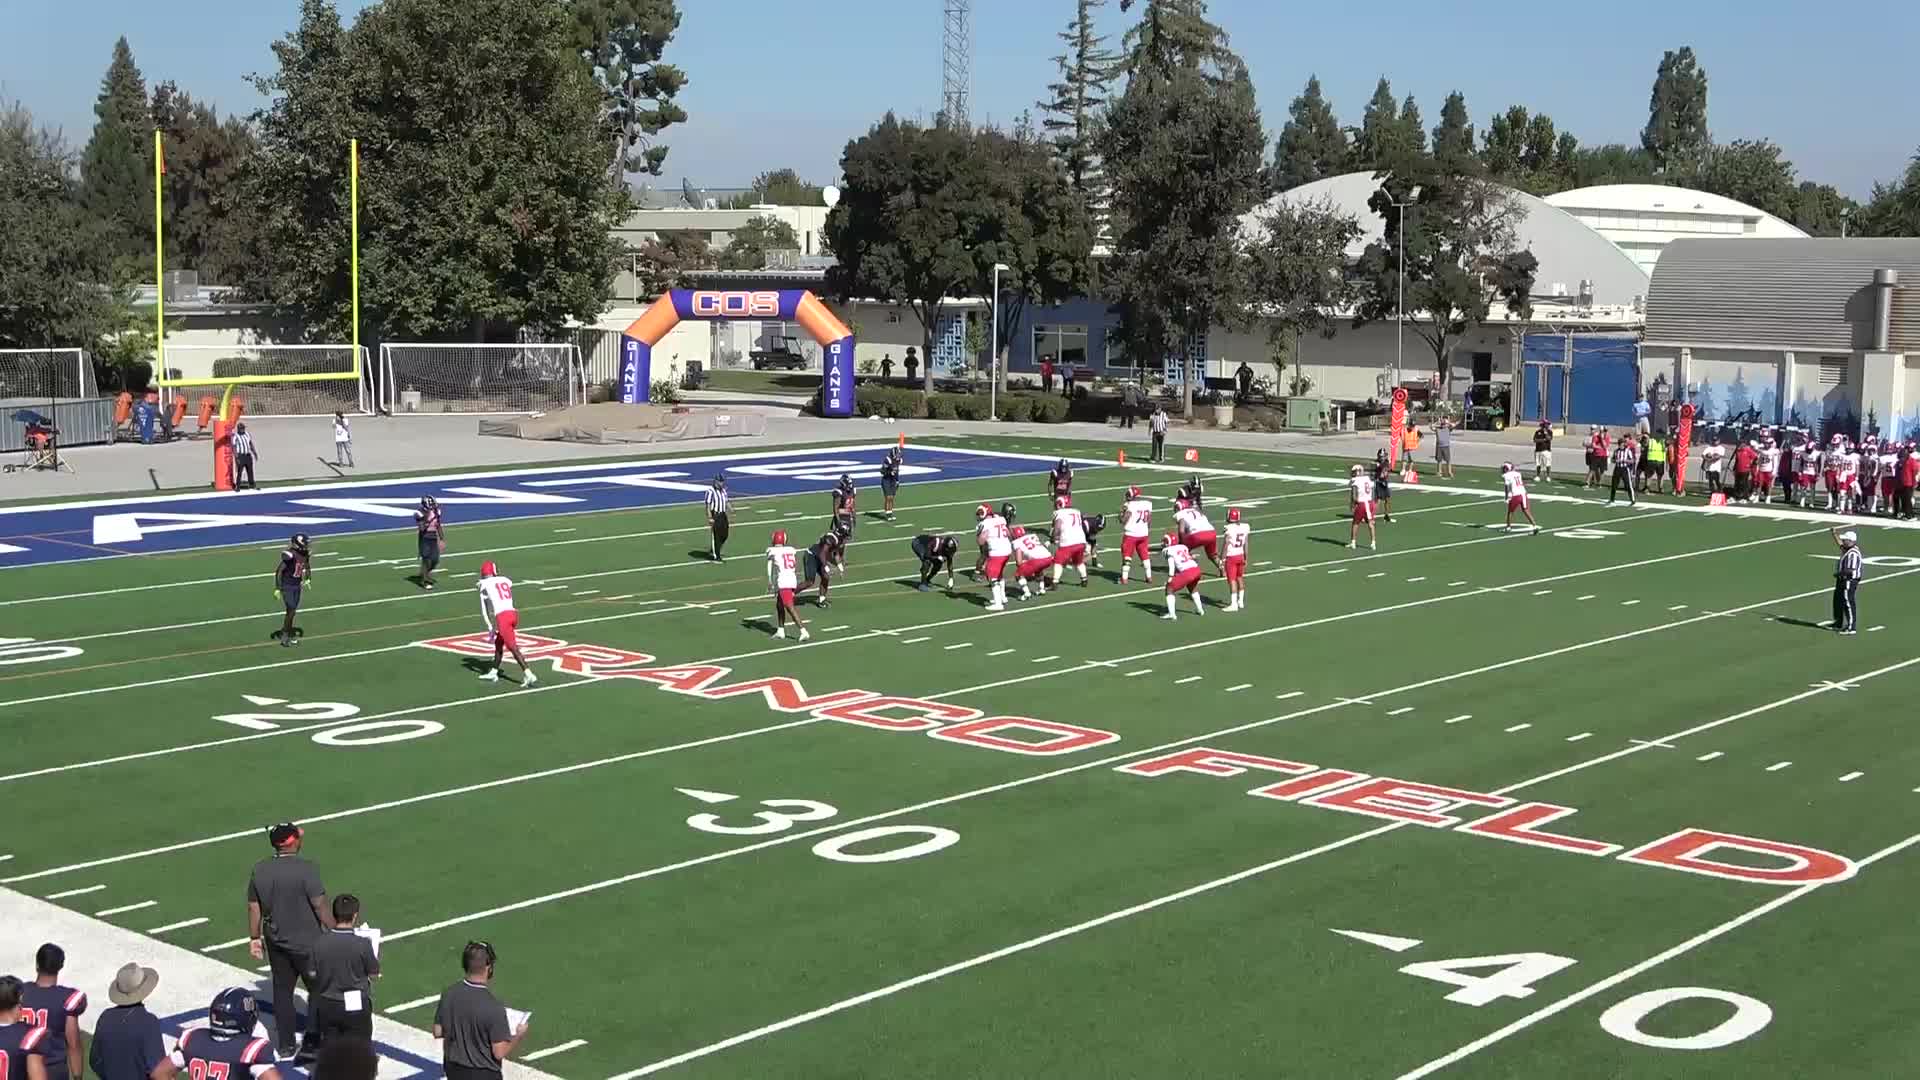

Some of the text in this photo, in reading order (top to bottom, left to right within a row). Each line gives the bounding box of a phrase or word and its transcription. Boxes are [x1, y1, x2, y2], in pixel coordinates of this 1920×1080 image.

[692, 290, 779, 316] COS
[623, 341, 639, 404] GIANTS
[830, 344, 841, 409] GIANTS
[0, 458, 943, 554] ANTS
[994, 523, 1008, 539] 75
[494, 581, 513, 601] 19
[781, 552, 797, 571] 15
[212, 701, 446, 747] 20
[418, 631, 1860, 885] BRANCO FIELD
[686, 799, 960, 864] 30
[1398, 951, 1774, 1050] 40
